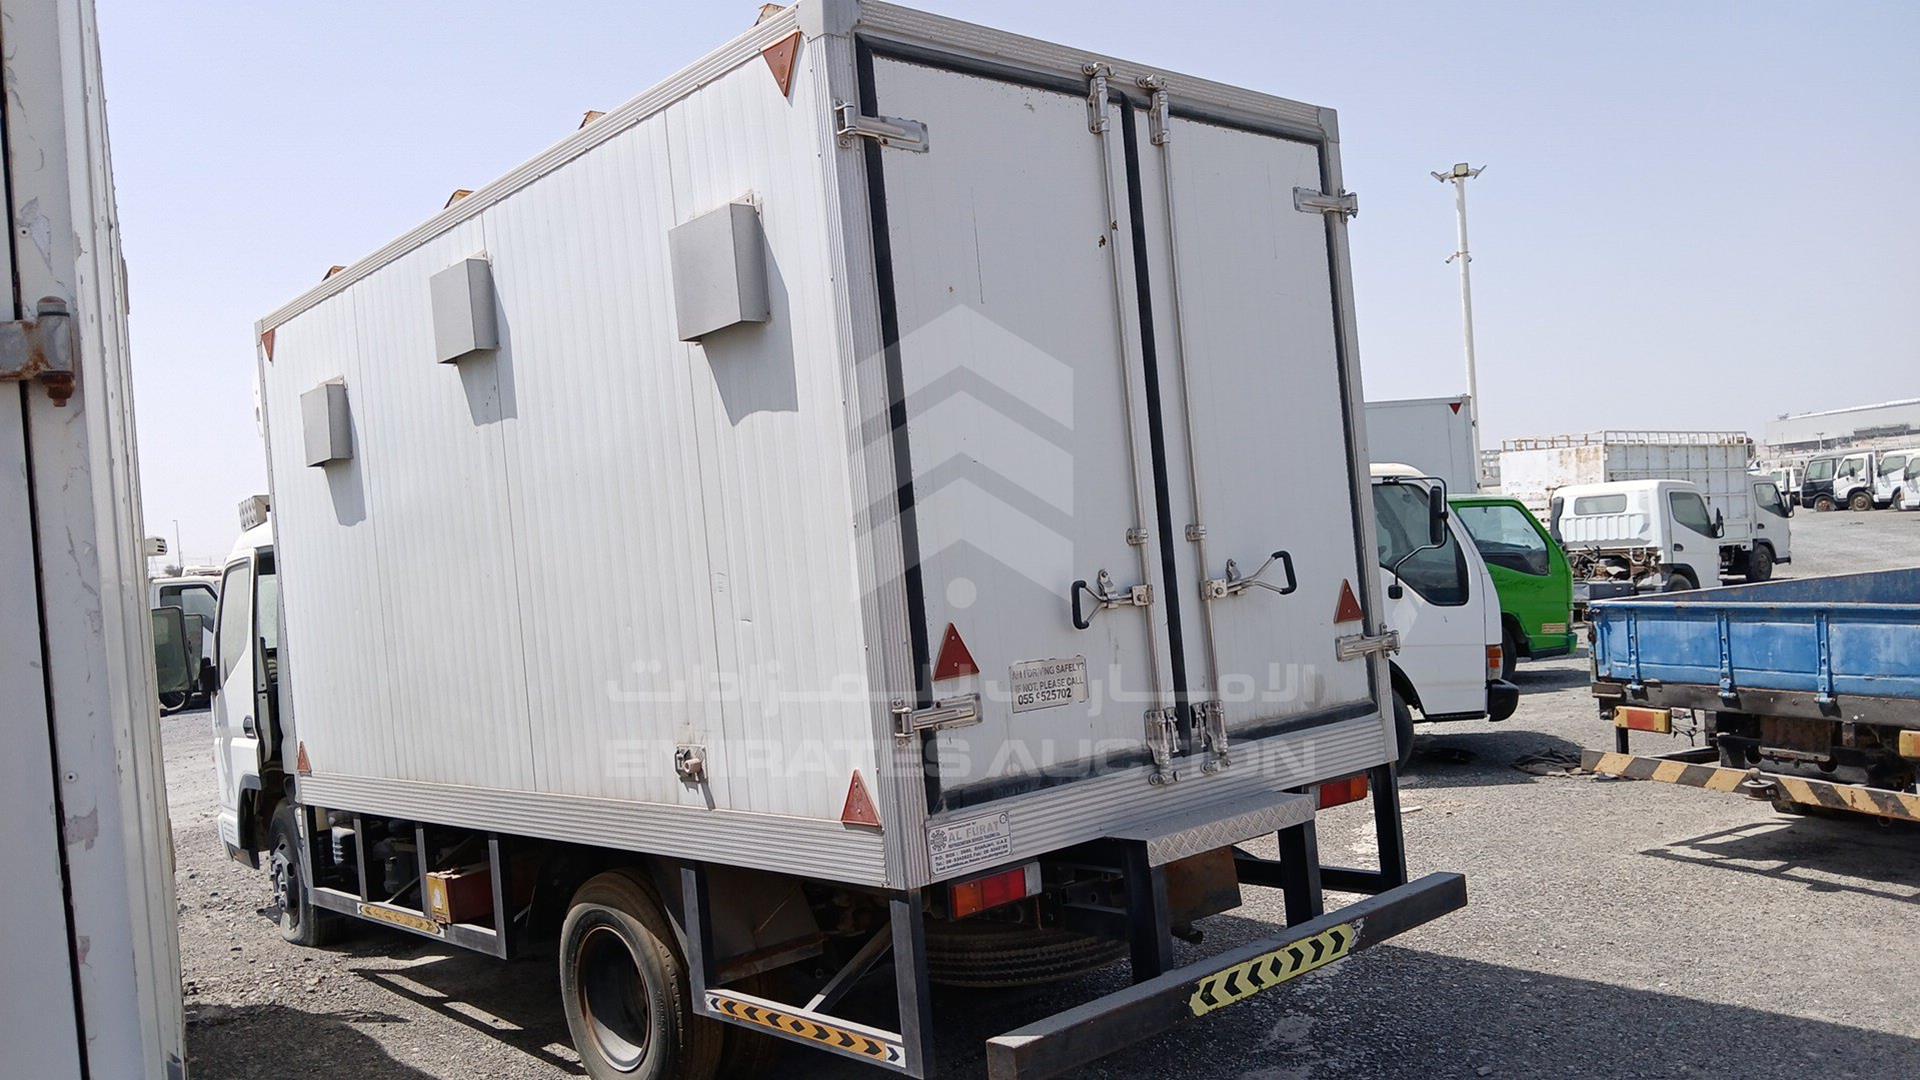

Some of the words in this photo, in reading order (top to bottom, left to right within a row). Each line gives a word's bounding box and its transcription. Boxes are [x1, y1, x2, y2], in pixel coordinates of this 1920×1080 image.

[1040, 678, 1065, 690] PLEASE
[1066, 676, 1084, 687] CALL
[1017, 692, 1034, 706] 055
[966, 821, 999, 838] FURAT
